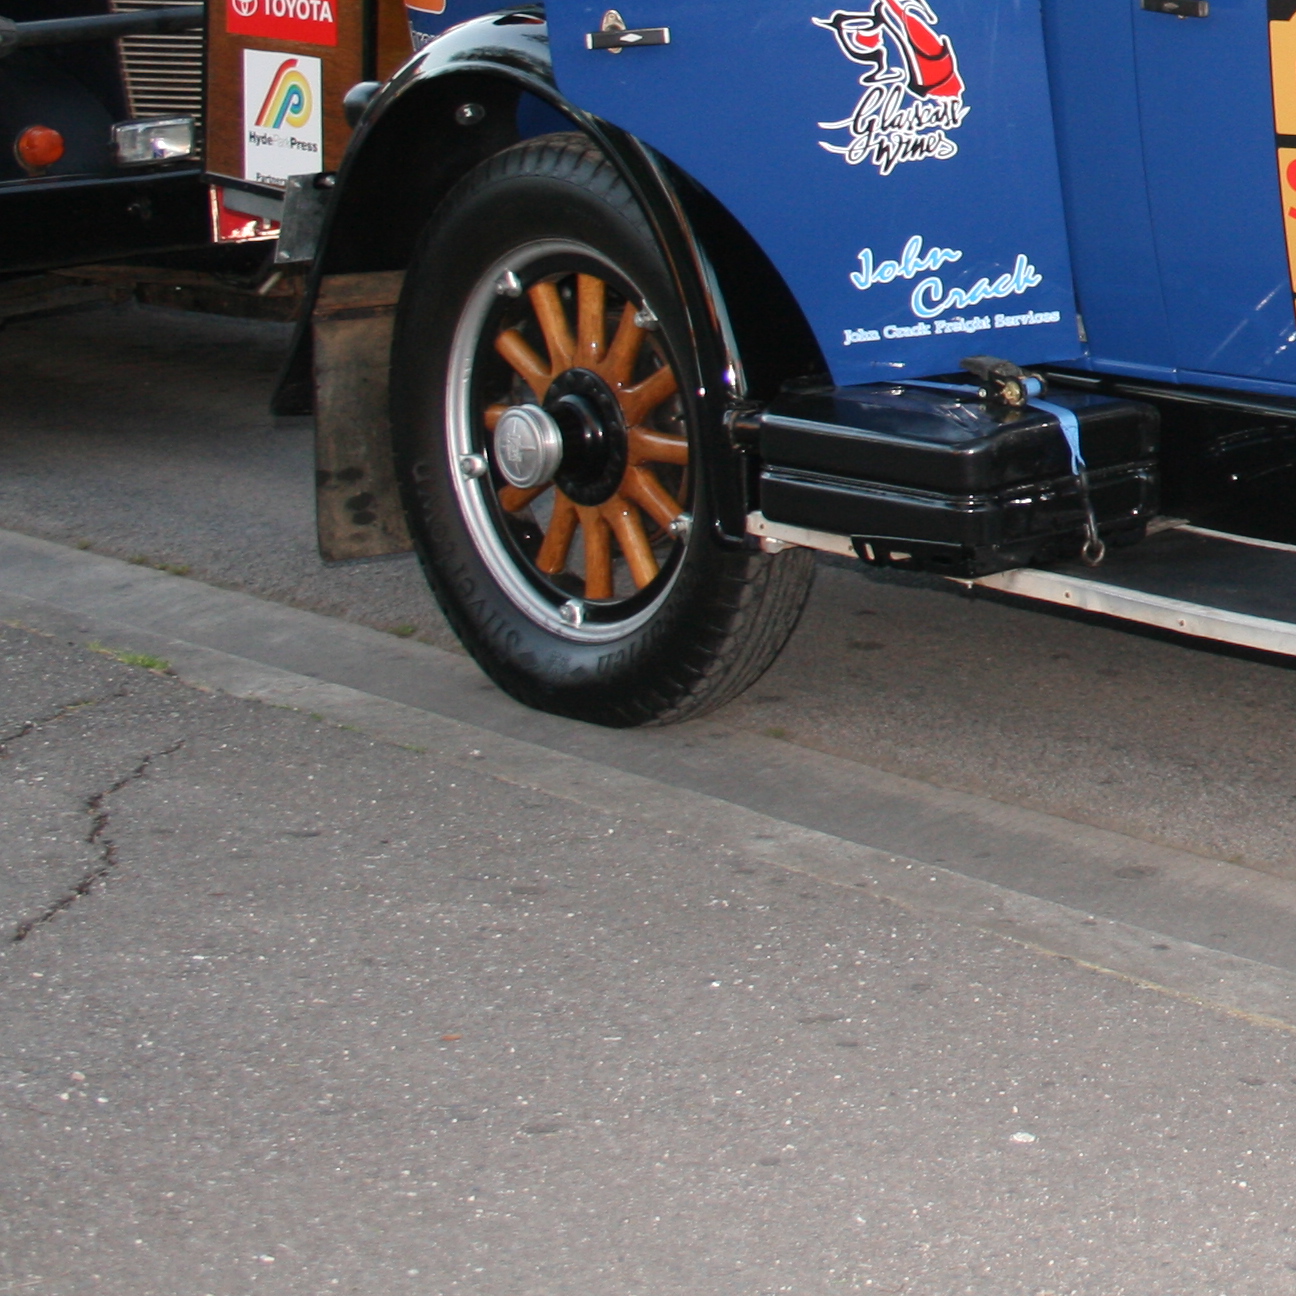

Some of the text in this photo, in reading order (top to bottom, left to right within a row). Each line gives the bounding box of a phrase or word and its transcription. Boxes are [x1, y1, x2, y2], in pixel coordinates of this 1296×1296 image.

[850, 235, 963, 290] John
[911, 254, 1043, 318] Crack
[843, 309, 1061, 346] John Crack Freight Services
